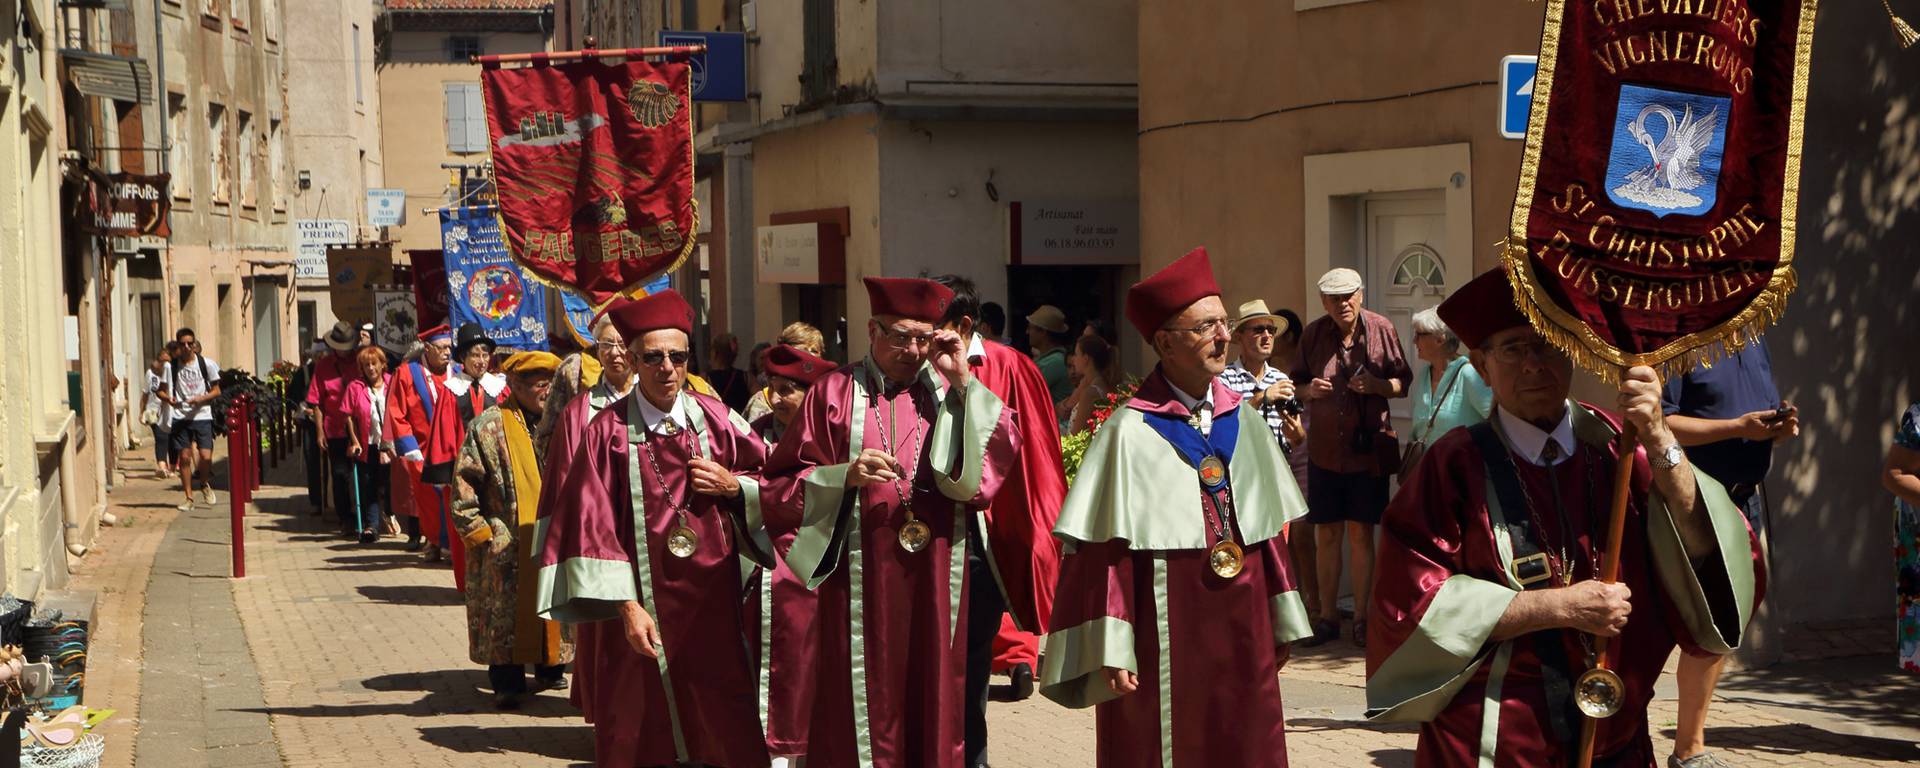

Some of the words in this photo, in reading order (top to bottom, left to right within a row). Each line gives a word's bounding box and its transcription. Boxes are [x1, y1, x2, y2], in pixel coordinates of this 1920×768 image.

[1594, 0, 1767, 47] CHEVALIERS
[1594, 30, 1753, 95] VIGNERONS
[94, 211, 136, 229] HOMME
[1034, 208, 1084, 220] Artisanat
[1588, 203, 1765, 268] CHRISTOPHE
[523, 219, 683, 263] FAUGERES
